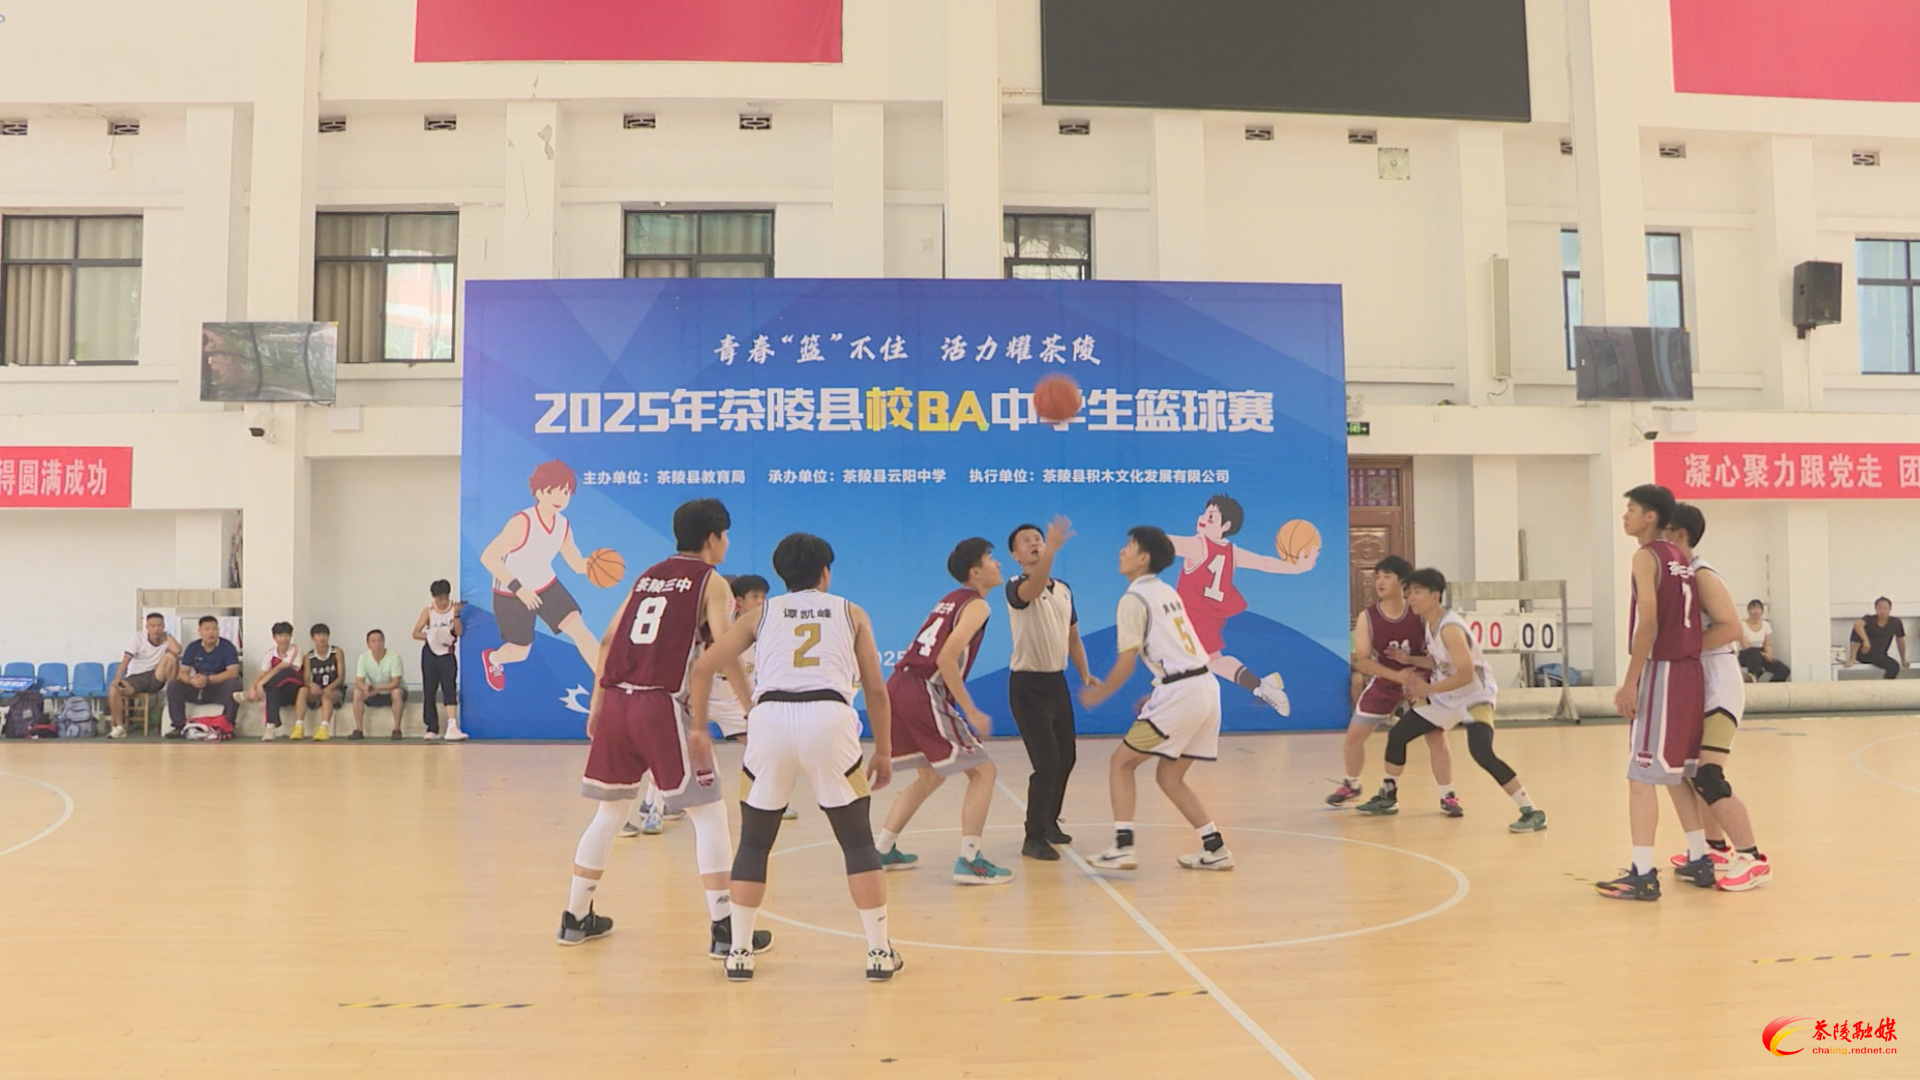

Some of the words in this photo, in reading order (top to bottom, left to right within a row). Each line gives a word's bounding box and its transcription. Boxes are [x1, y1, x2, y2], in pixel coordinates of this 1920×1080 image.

[713, 333, 909, 366] 青春“篮”不住
[940, 334, 1102, 366] 活力耀茶陵
[534, 387, 1275, 432] 2025年茶陵县校BA中生篮球赛
[583, 469, 745, 486] 主办单位：茶陵县教育局
[768, 469, 947, 485] 承办单位：茶陵县云阳中学
[969, 469, 1230, 485] 执行单位：茶陵县积木文化发展有限公司
[1684, 453, 1883, 488] 凝心聚力跟党走
[634, 577, 692, 594] 茶陵三中
[1203, 554, 1226, 602] 1
[629, 596, 667, 645] 8
[916, 617, 944, 657] 4
[1173, 617, 1196, 657] 5
[793, 623, 821, 668] 2
